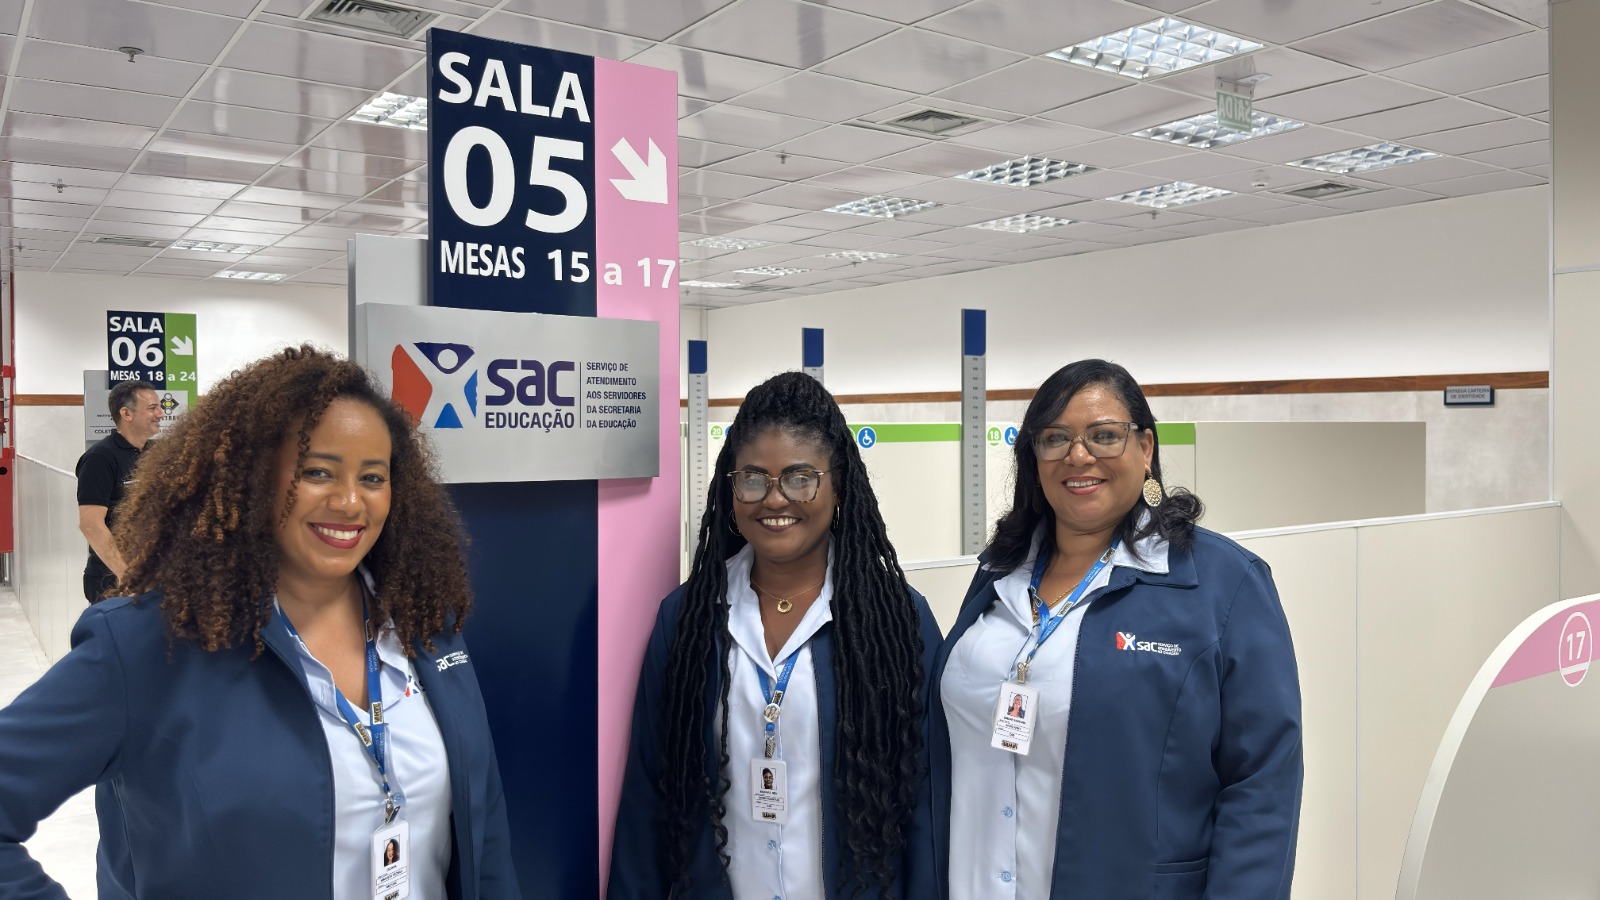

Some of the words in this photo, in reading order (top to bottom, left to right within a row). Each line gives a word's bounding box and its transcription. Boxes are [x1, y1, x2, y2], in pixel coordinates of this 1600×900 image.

[438, 51, 591, 123] SALA
[443, 126, 588, 234] 05
[440, 240, 526, 279] MESAS
[547, 248, 590, 283] 15
[603, 262, 623, 286] a
[637, 257, 677, 289] 17
[109, 316, 164, 333] SALA
[111, 336, 164, 367] 06
[586, 362, 618, 373] SERVIÇO
[619, 363, 629, 372] DE
[110, 370, 141, 381] MESAS
[147, 371, 164, 381] 18
[167, 373, 176, 381] a
[180, 371, 197, 381] 24
[485, 358, 575, 407] sac
[586, 376, 637, 386] ATENDIMENTO
[586, 391, 602, 400] AOS
[603, 391, 647, 400] SERVIDORES
[586, 405, 598, 414] DA
[599, 405, 642, 414] SECRETARIA
[485, 408, 575, 433] EDUCAÇÃO
[586, 419, 598, 428] DA
[599, 418, 637, 430] EDUCAÇÃO
[712, 427, 722, 435] 20
[989, 430, 999, 440] 18
[1566, 630, 1586, 661] 17
